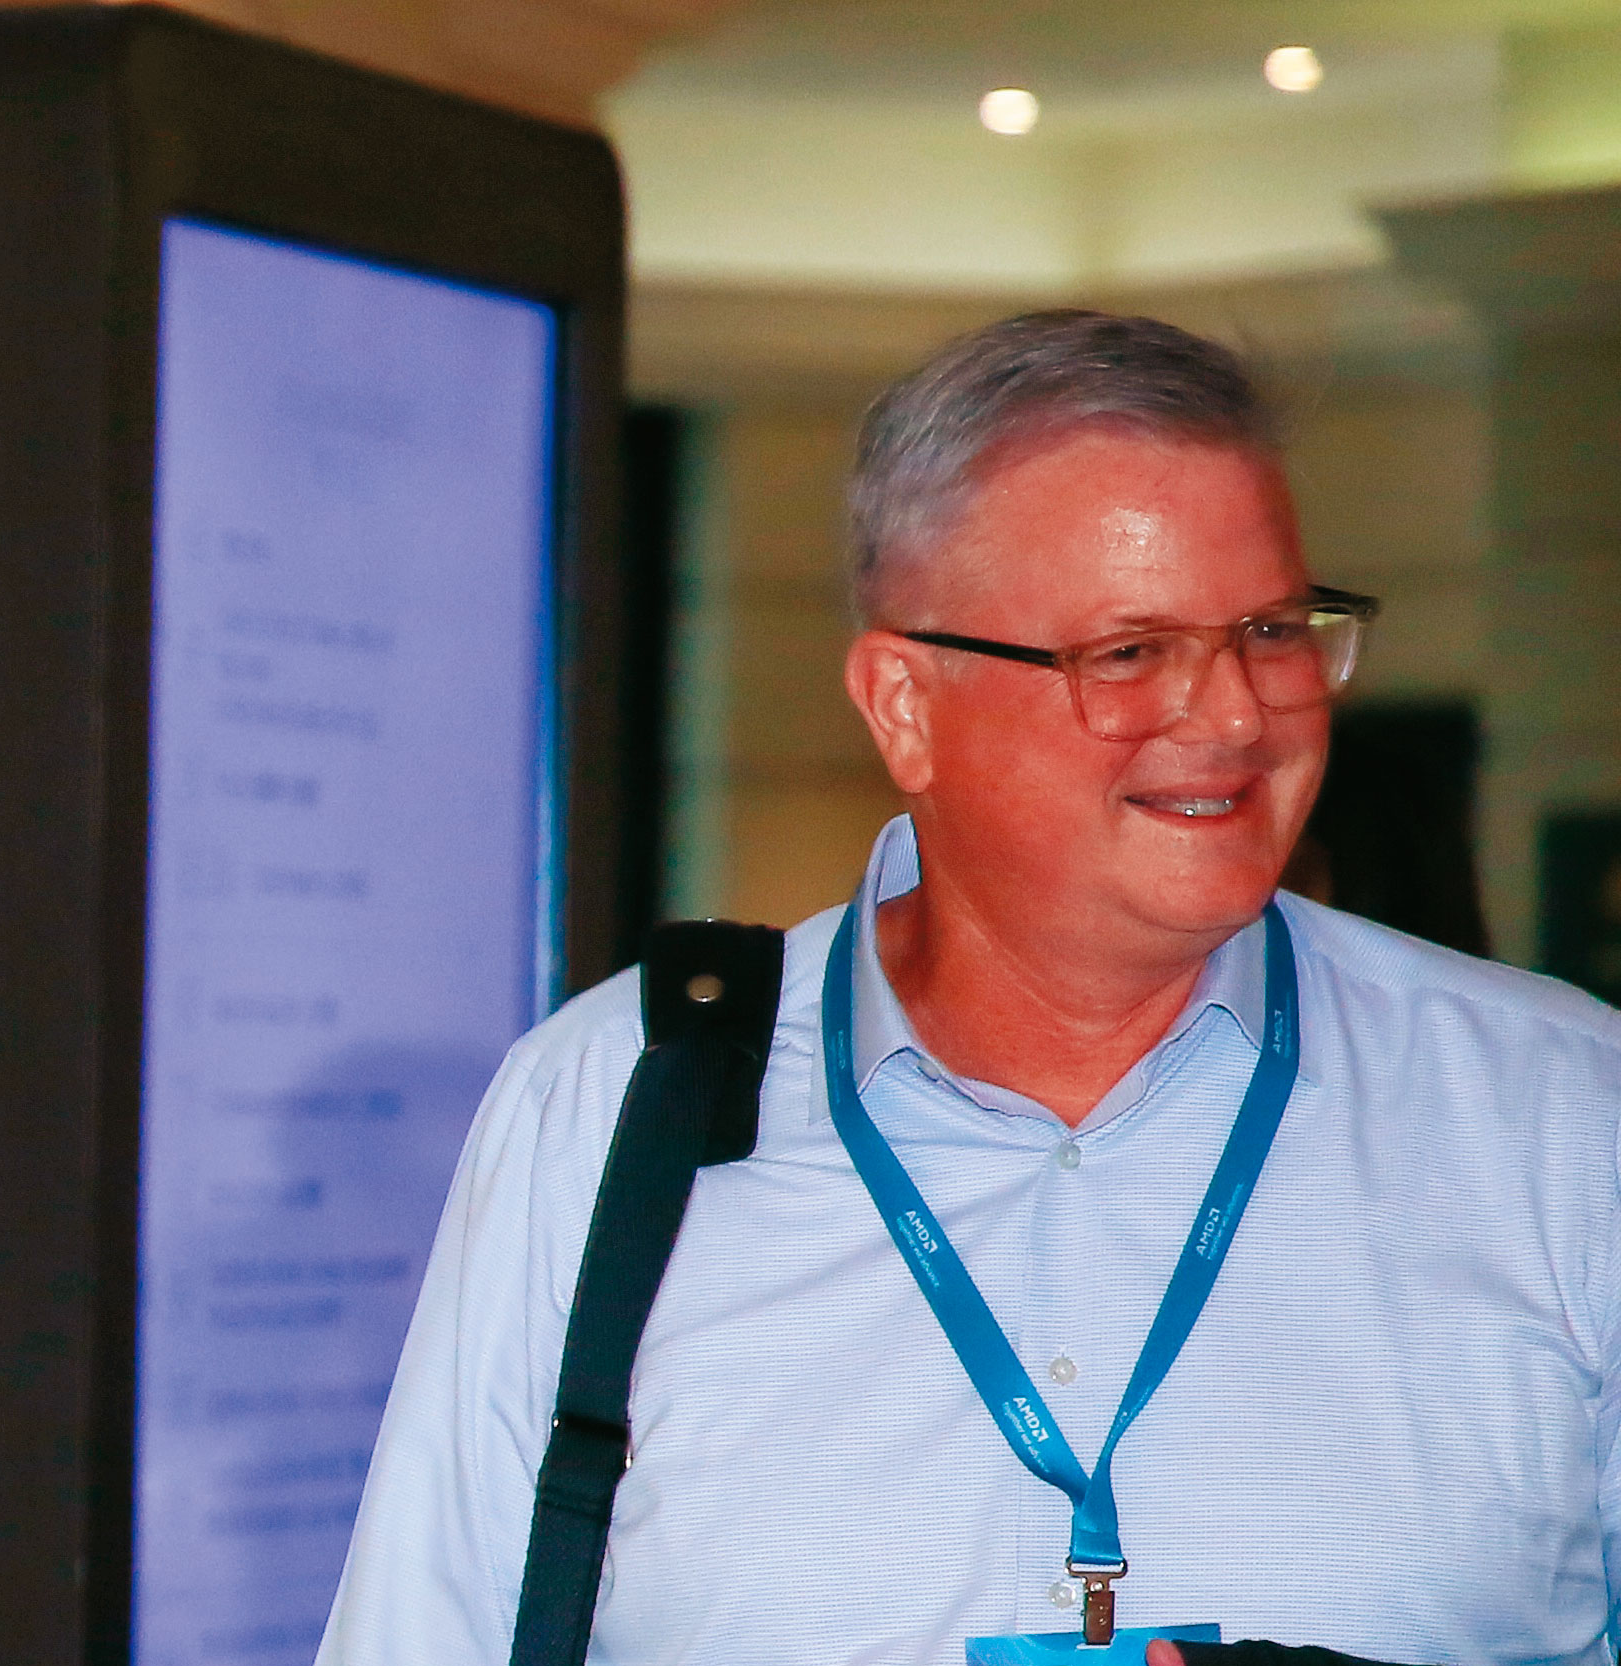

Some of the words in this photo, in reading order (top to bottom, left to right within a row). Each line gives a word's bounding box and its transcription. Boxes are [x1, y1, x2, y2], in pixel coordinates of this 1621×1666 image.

[904, 1210, 930, 1242] AMD
[1195, 1221, 1215, 1257] AMD
[1012, 1397, 1041, 1429] AMD
